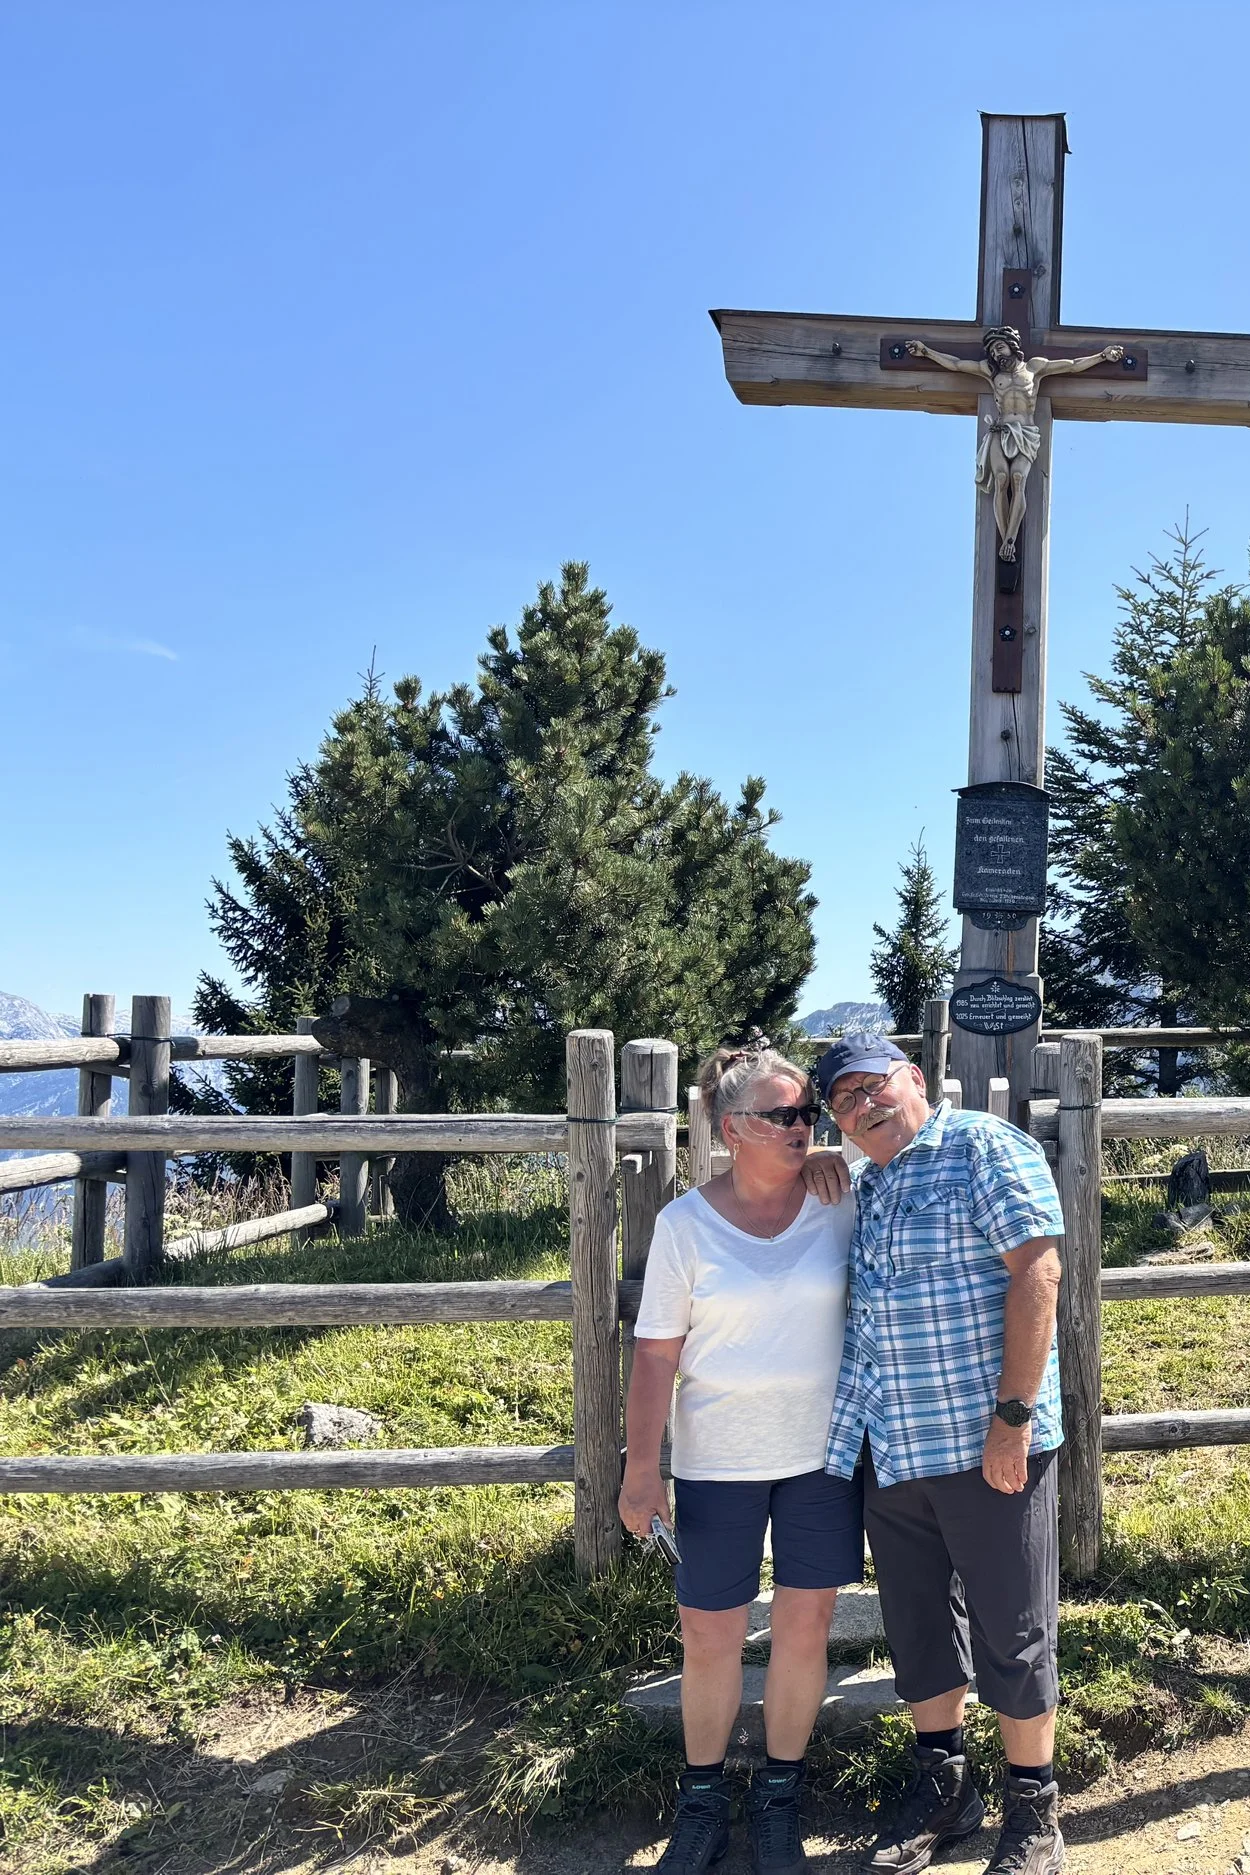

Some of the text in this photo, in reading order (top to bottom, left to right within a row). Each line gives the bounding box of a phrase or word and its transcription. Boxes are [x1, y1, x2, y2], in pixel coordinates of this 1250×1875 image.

[966, 817, 980, 825] Zum
[973, 834, 1024, 843] den gefallenen
[977, 866, 1021, 875] Kameraden
[1008, 1013, 1032, 1021] geweiht
